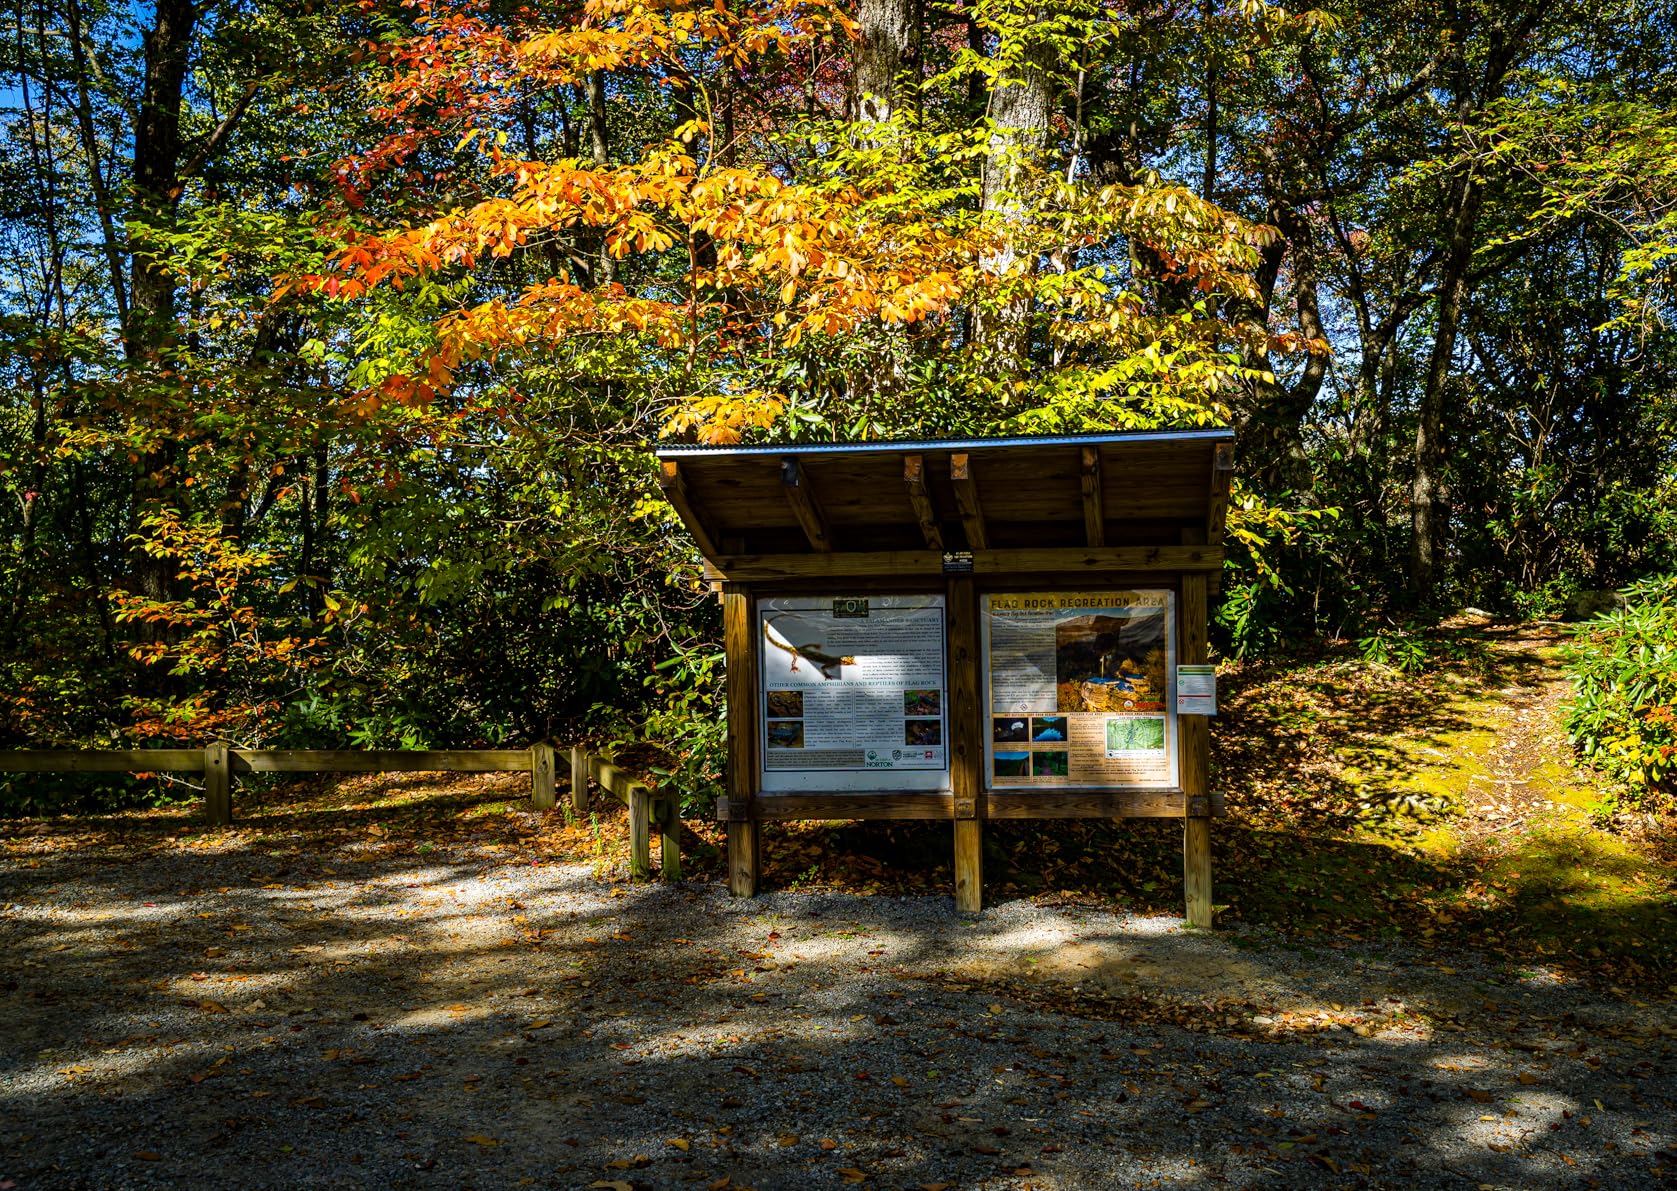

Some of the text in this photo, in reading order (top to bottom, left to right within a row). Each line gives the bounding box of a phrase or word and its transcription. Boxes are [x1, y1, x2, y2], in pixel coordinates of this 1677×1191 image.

[991, 597, 1164, 609] FLAG ROCK RECREATION AREA
